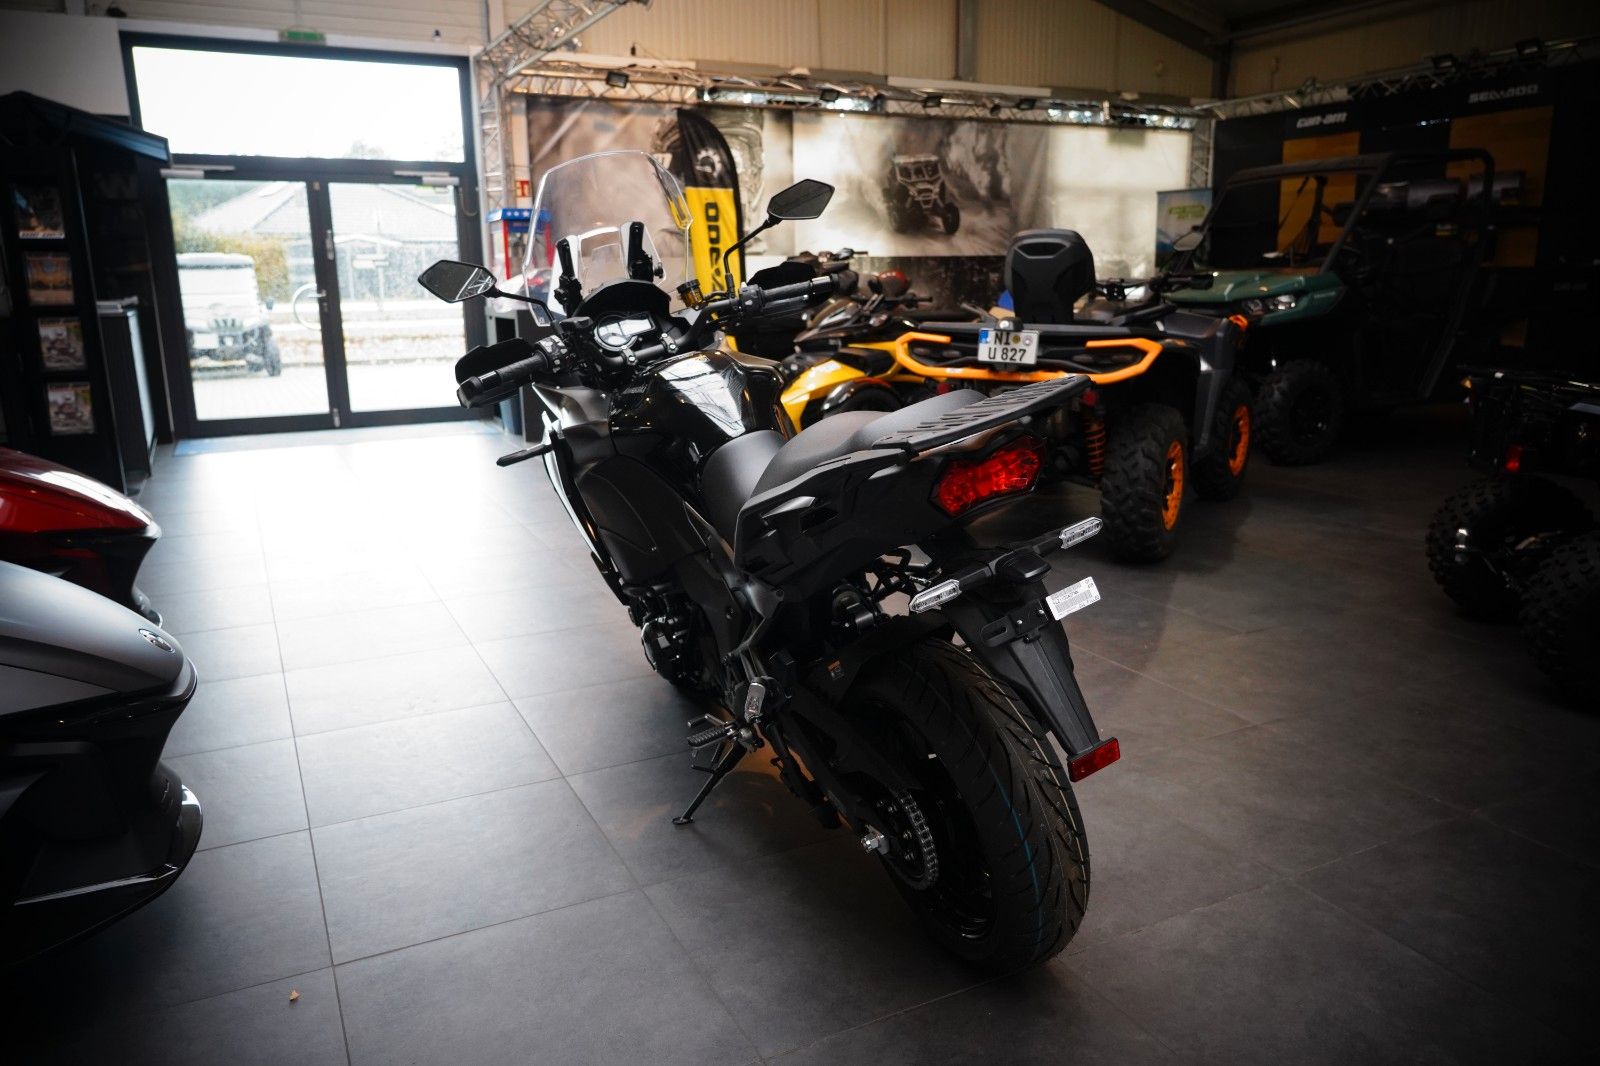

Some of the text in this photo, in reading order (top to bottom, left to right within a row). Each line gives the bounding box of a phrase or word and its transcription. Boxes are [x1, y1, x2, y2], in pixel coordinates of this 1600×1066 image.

[994, 331, 1011, 346] NI
[988, 347, 1027, 362] U 827
